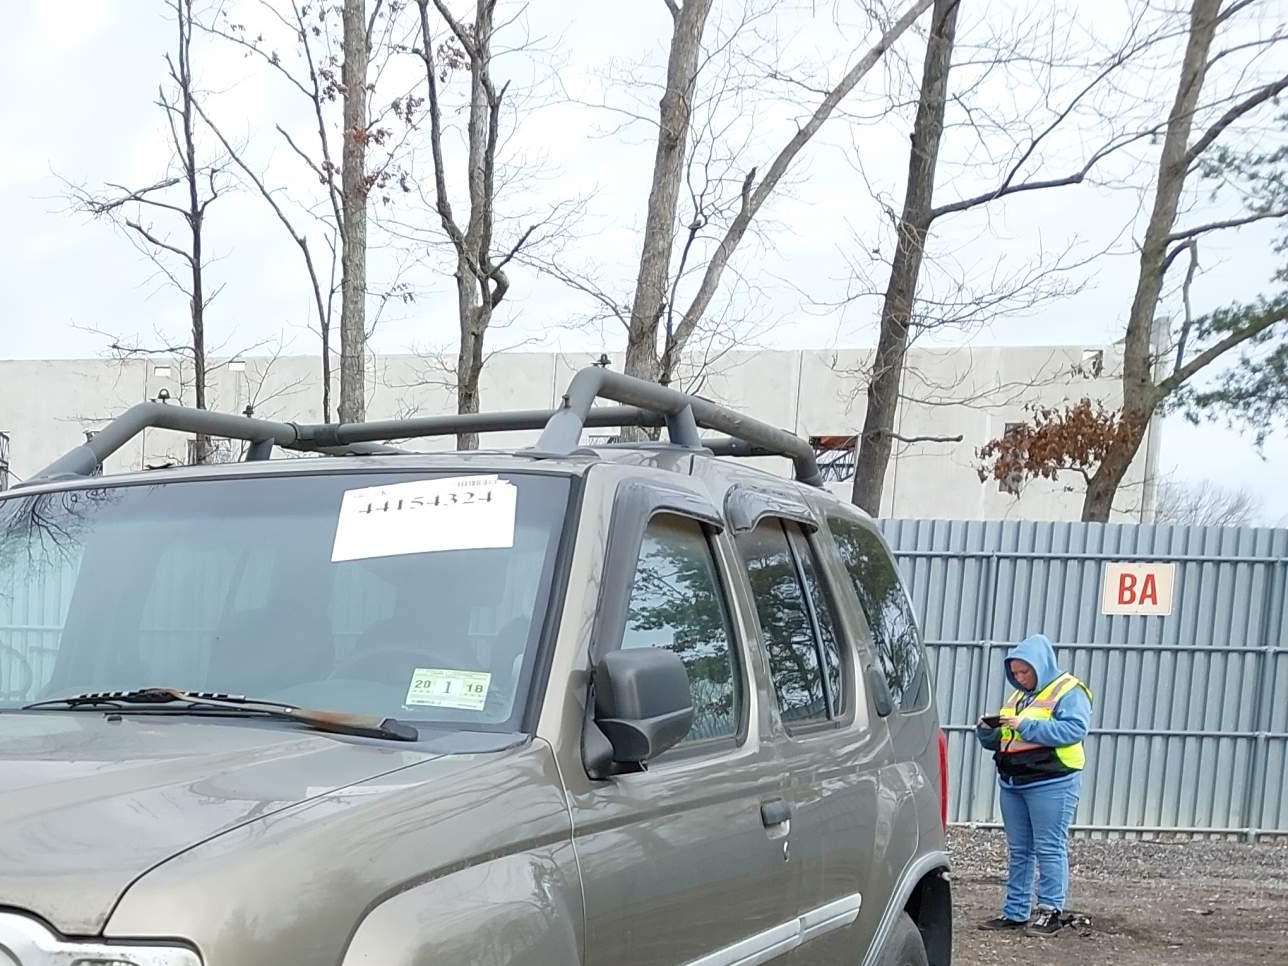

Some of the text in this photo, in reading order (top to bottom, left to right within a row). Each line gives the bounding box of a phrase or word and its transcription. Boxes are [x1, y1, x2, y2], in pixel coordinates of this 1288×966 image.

[358, 491, 494, 515] 44154324
[1118, 573, 1158, 605] BA
[414, 679, 484, 694] 20 1 18
